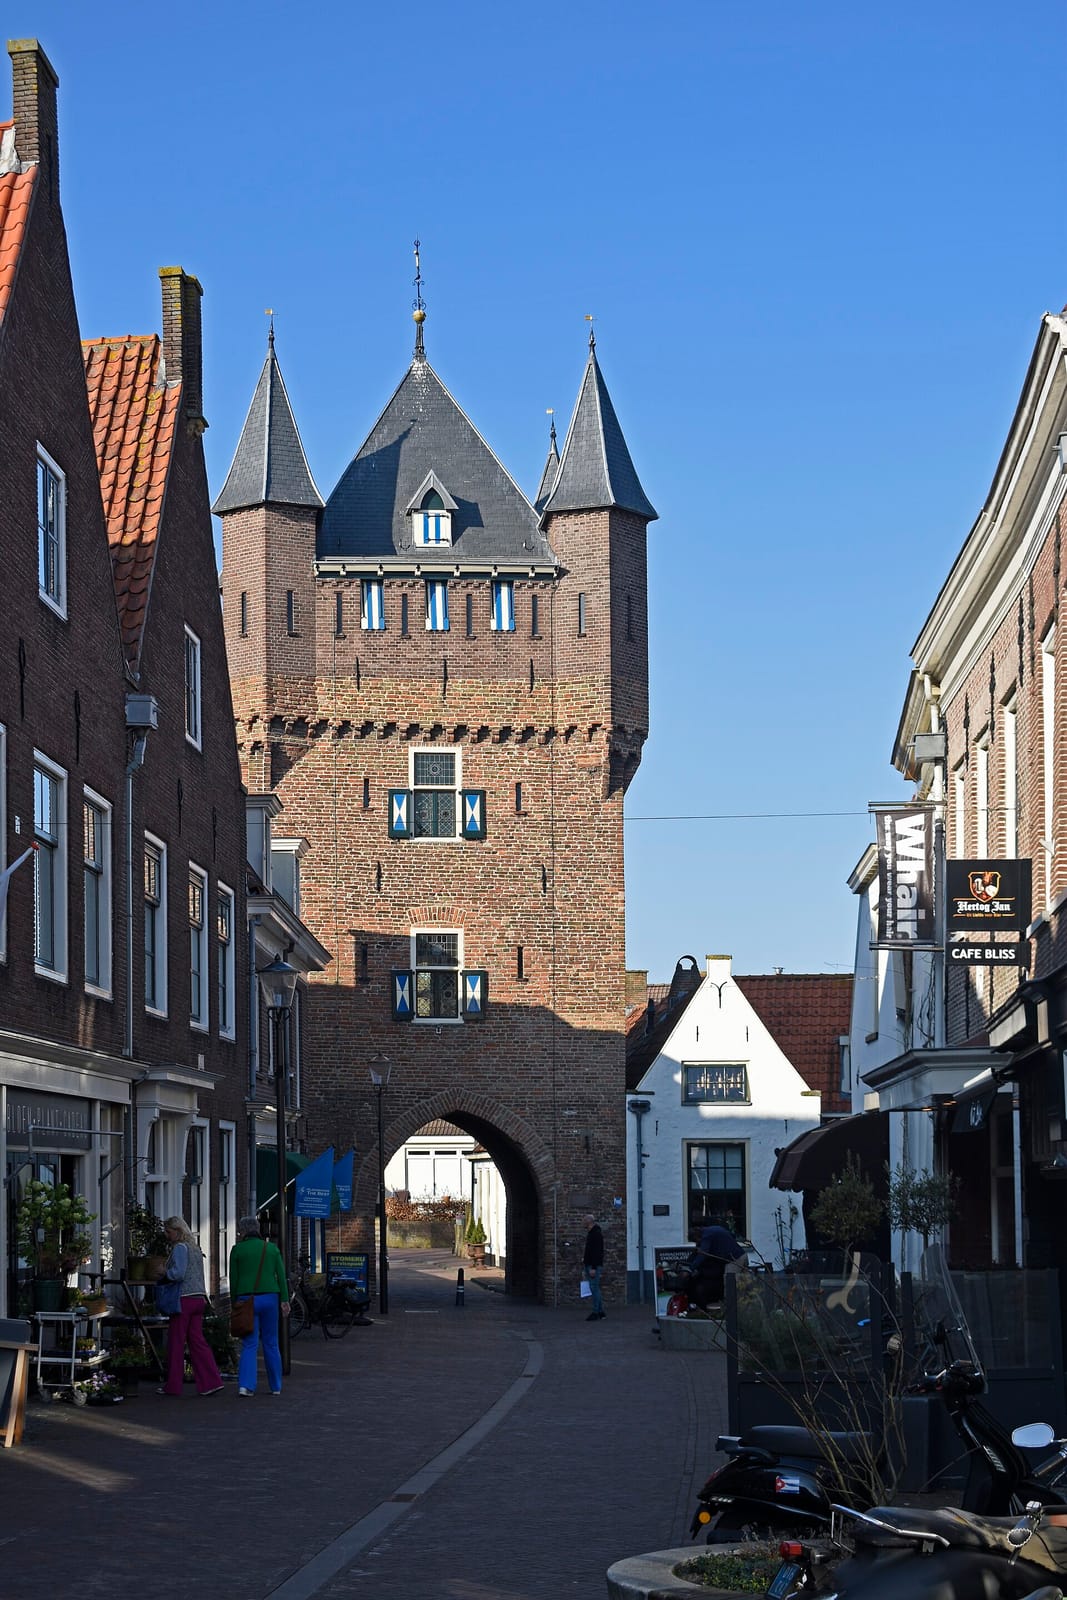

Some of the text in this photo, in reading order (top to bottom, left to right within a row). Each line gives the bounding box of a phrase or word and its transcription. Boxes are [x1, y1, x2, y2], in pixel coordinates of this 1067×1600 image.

[884, 814, 893, 830] the
[884, 853, 892, 870] you
[885, 897, 893, 918] your
[957, 901, 1011, 914] Hertog Jan
[885, 920, 894, 939] hair
[951, 948, 1016, 959] CAFE BLISS
